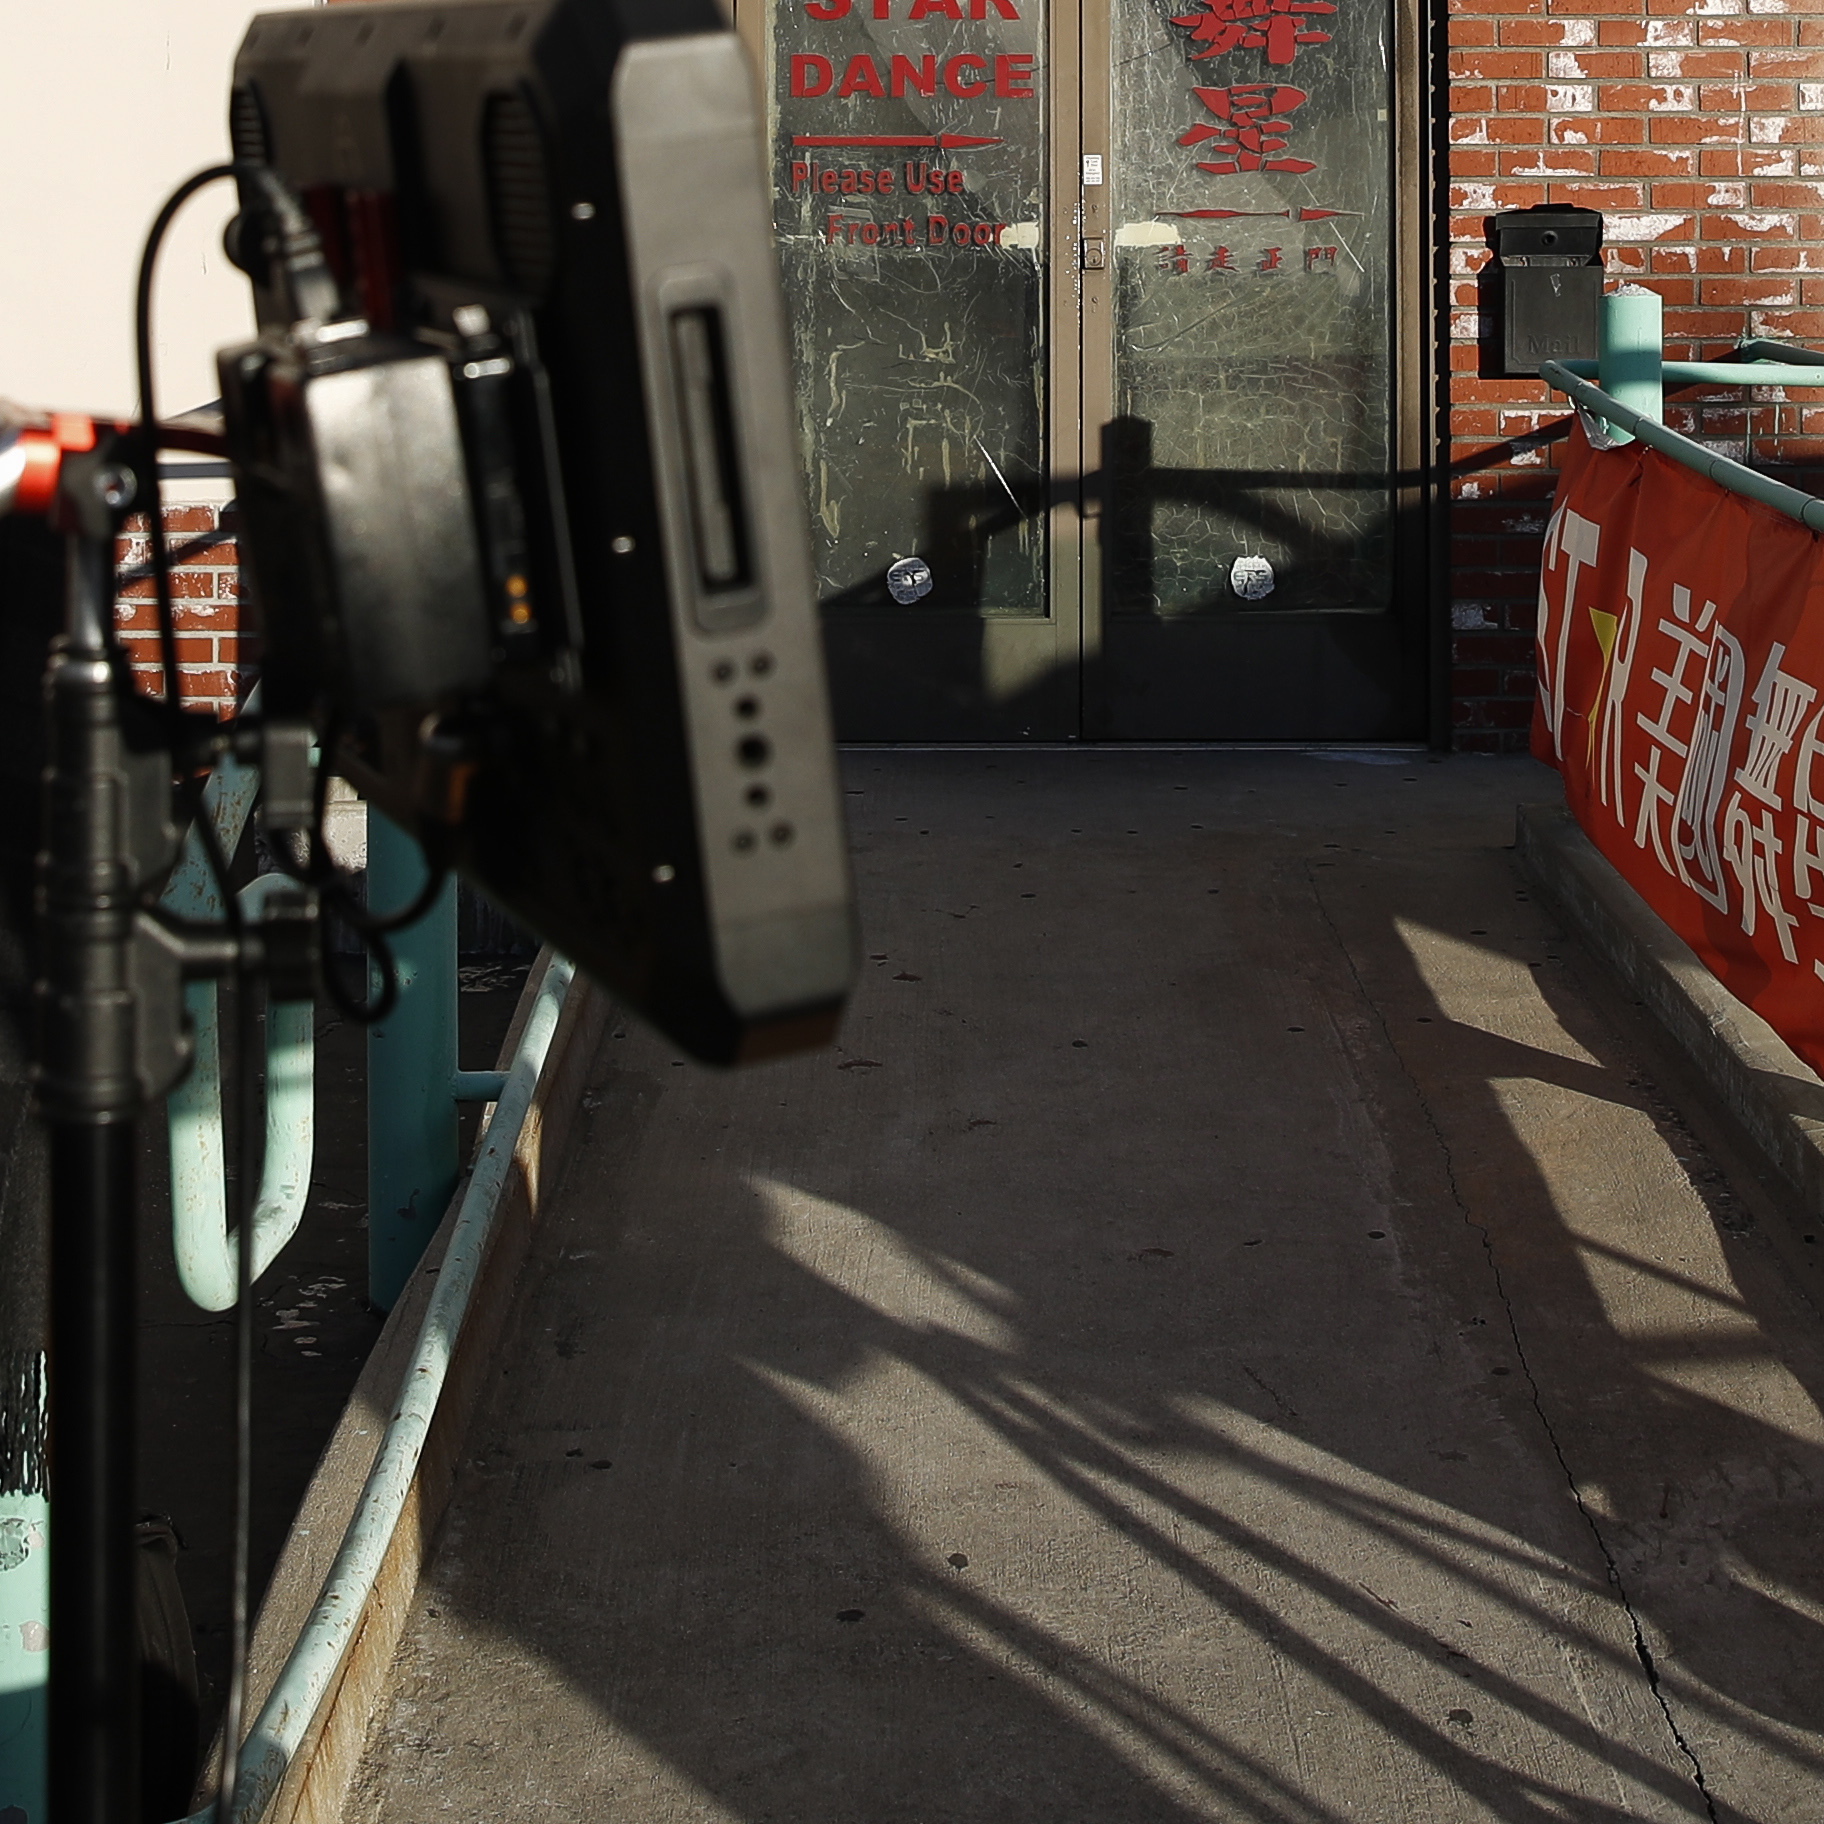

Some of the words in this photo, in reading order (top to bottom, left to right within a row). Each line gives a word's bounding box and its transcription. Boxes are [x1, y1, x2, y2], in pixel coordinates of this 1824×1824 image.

[790, 52, 1035, 99] DANCE
[791, 161, 895, 194] Please
[904, 161, 965, 194] Use
[826, 213, 916, 246] Front
[928, 213, 1008, 246] Door
[1526, 333, 1580, 355] Mail
